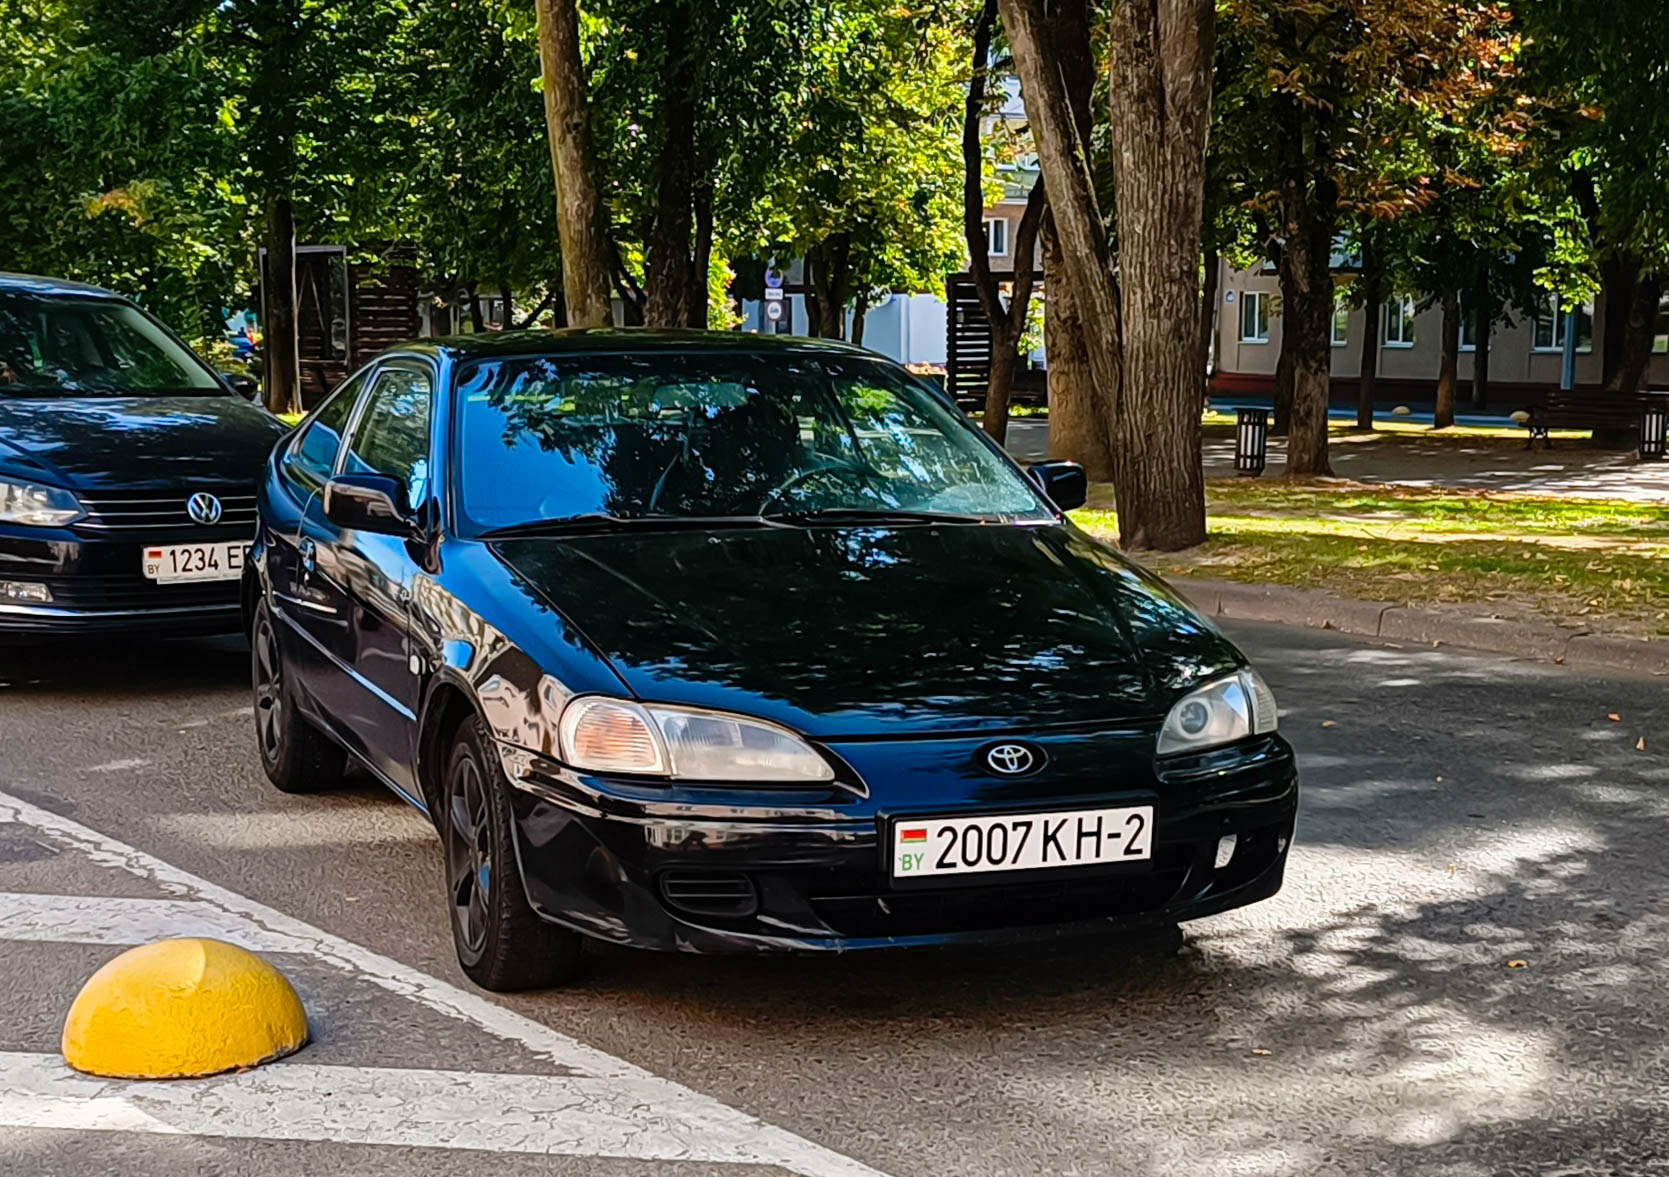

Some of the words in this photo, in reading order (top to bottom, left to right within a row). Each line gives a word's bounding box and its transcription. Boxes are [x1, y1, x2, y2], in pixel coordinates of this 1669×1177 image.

[147, 564, 160, 575] BY
[169, 547, 219, 573] 1234
[935, 821, 1033, 869] 2007
[1042, 813, 1146, 863] KH-2
[901, 853, 924, 871] BY
